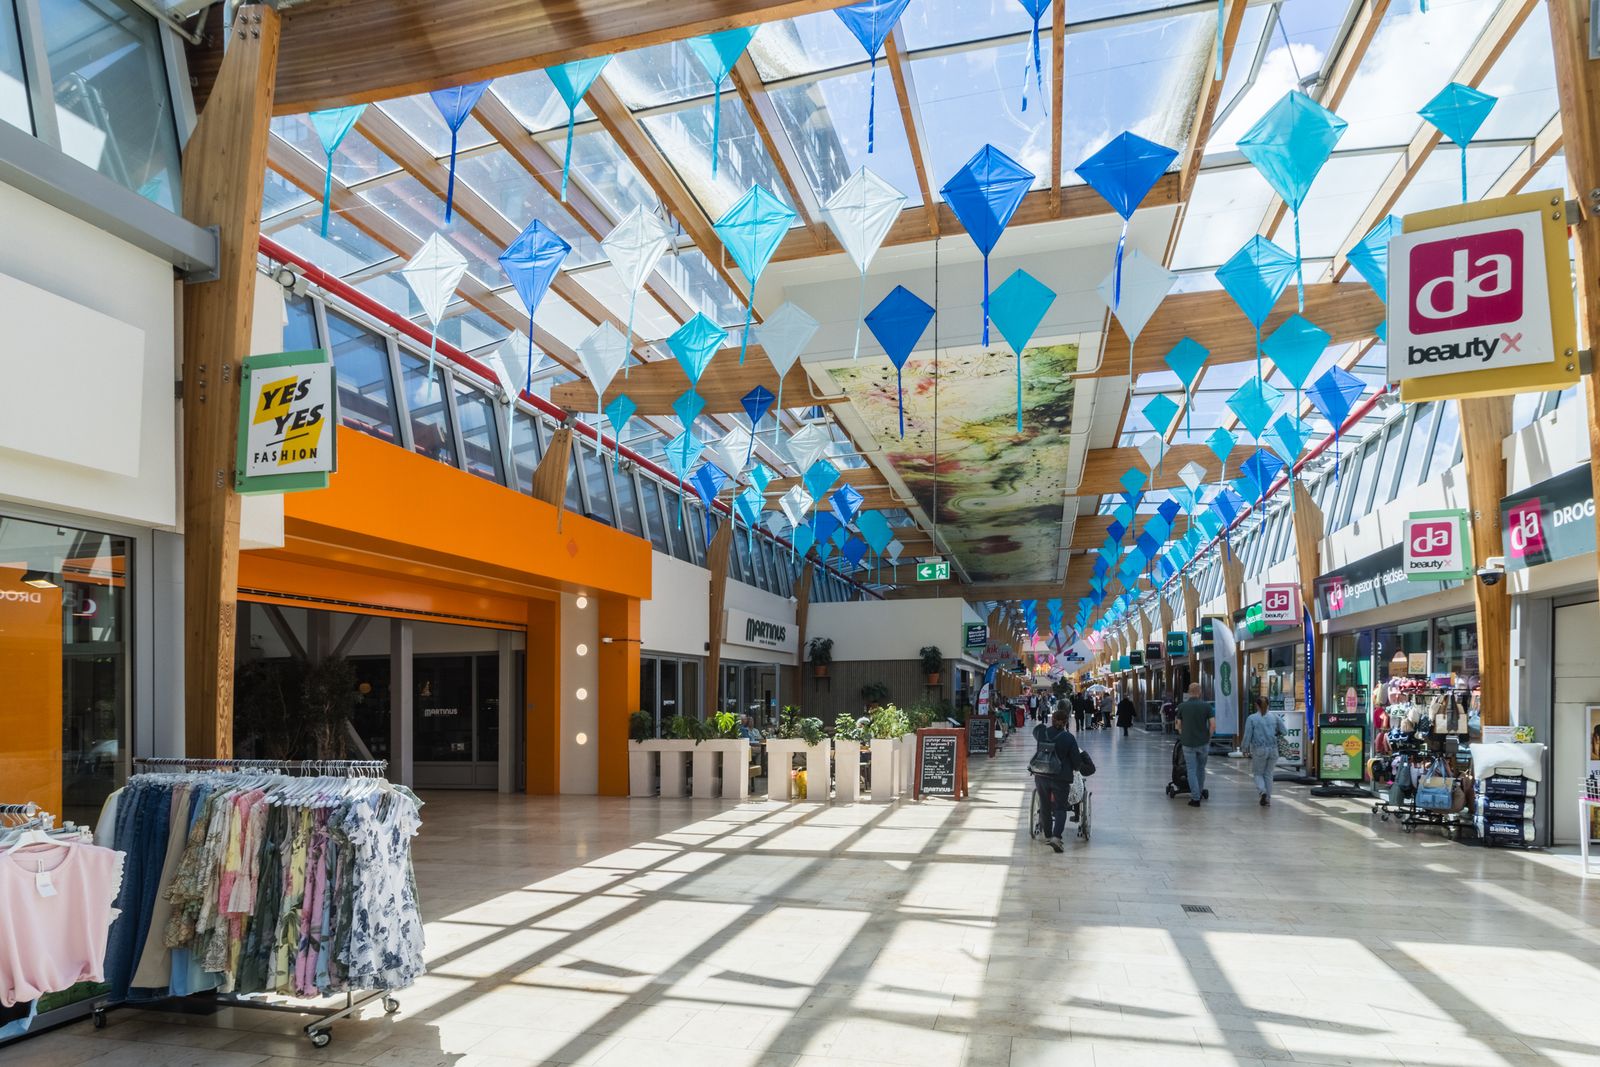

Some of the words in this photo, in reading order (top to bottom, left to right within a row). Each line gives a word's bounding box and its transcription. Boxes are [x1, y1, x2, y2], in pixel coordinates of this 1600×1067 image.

[1415, 248, 1512, 319] da
[263, 378, 312, 411] YES
[274, 403, 324, 436] YES
[254, 448, 317, 463] FASHION
[1511, 510, 1539, 550] da
[1553, 498, 1596, 527] DROG
[1412, 527, 1449, 553] da
[1266, 593, 1288, 609] da
[1330, 582, 1342, 606] da
[1344, 584, 1354, 598] De
[745, 617, 786, 642] MARTINUS
[424, 708, 458, 717] MARTINUS
